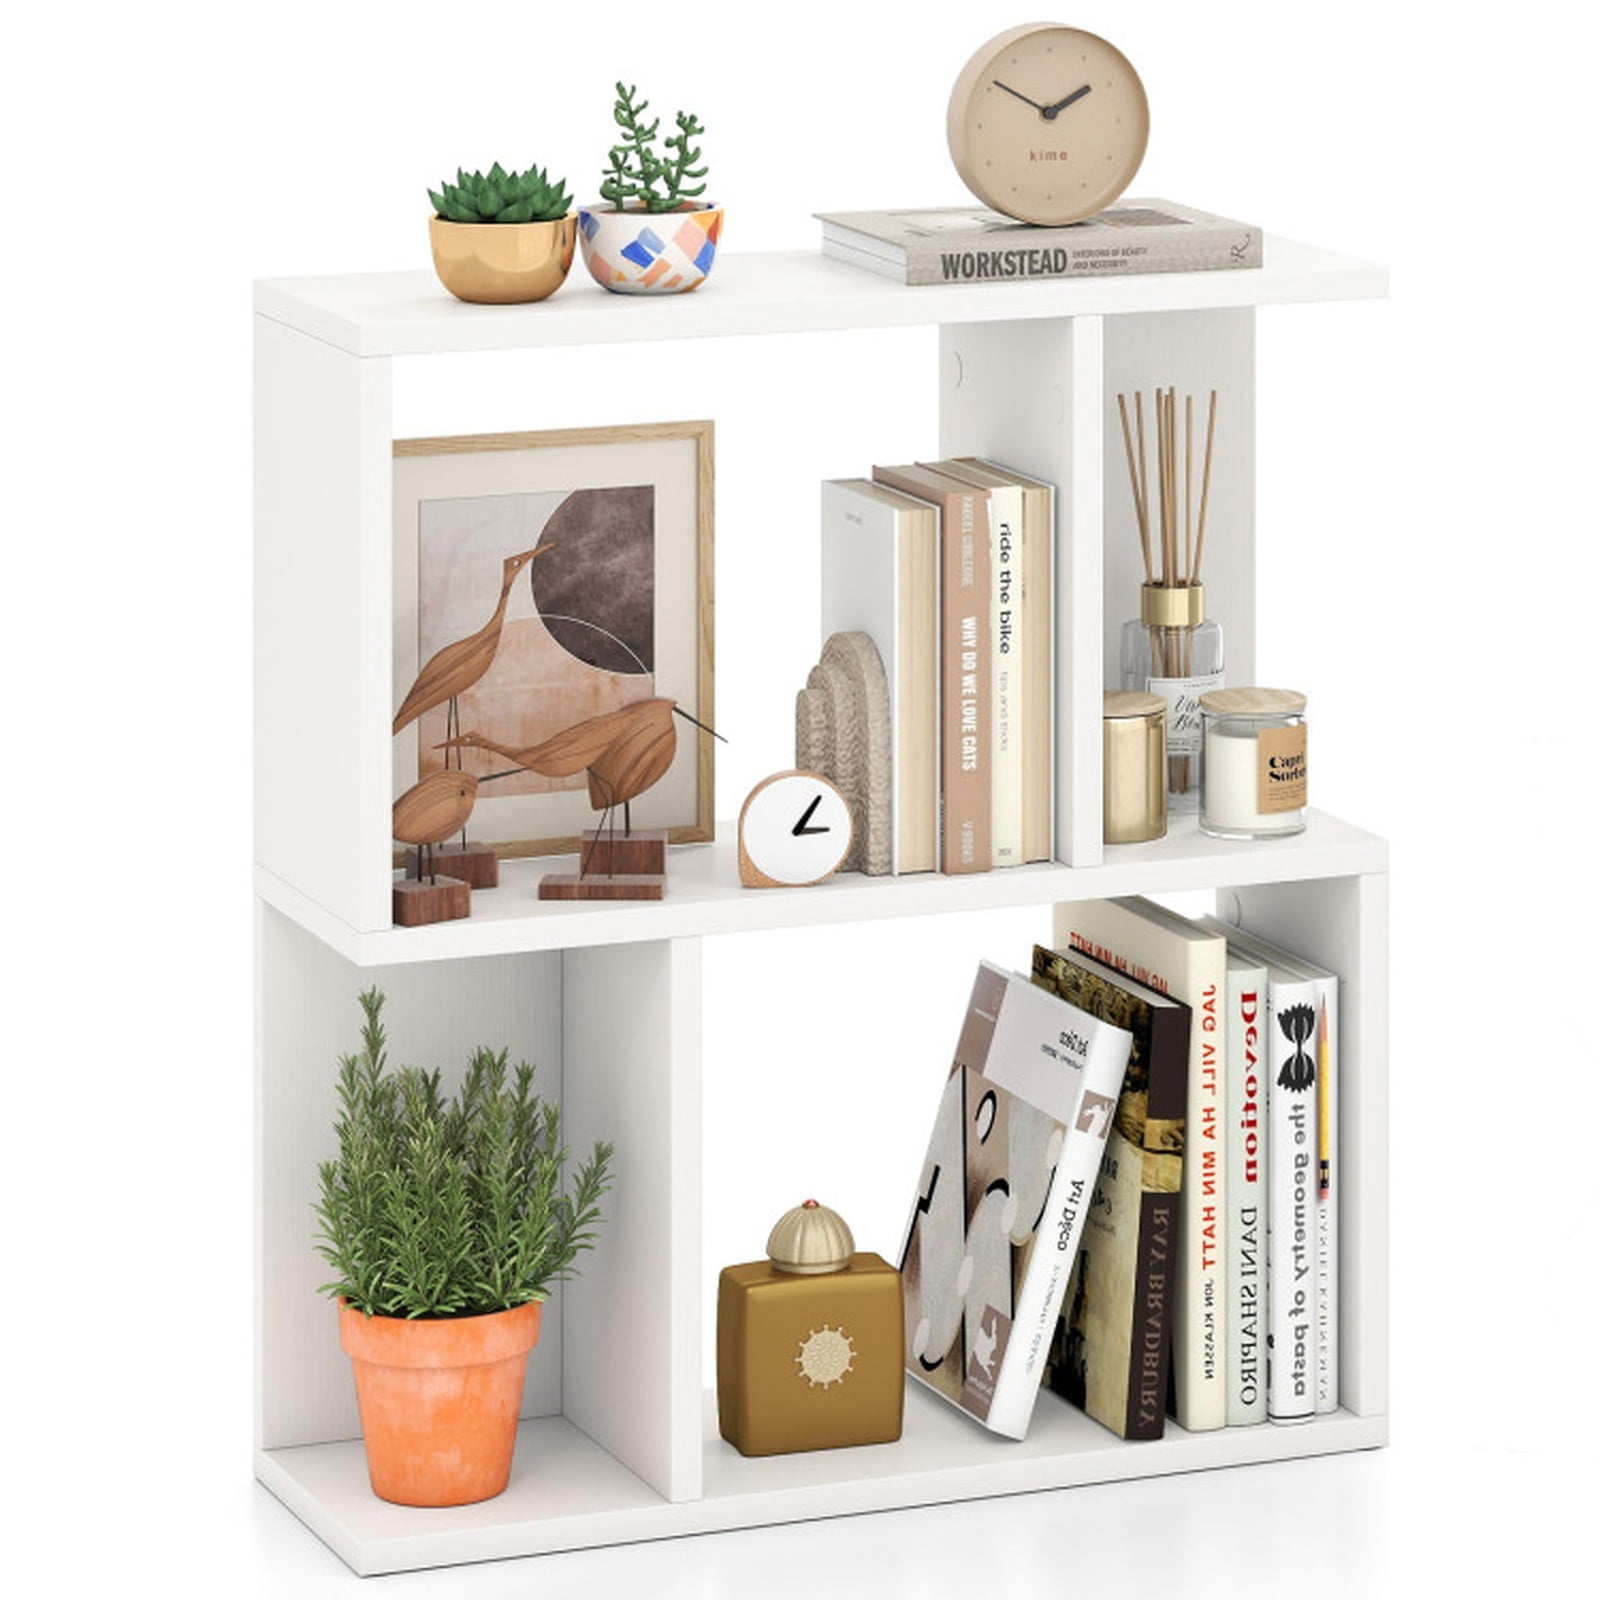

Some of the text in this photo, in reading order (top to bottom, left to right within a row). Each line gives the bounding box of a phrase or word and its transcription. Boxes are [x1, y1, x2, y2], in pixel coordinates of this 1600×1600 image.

[1029, 149, 1068, 162] kime
[940, 248, 1068, 280] WORKSTEAD
[999, 522, 1012, 655] ride the bike
[961, 616, 977, 771] WHY DO WE LOVE CATS
[999, 695, 1009, 719] and
